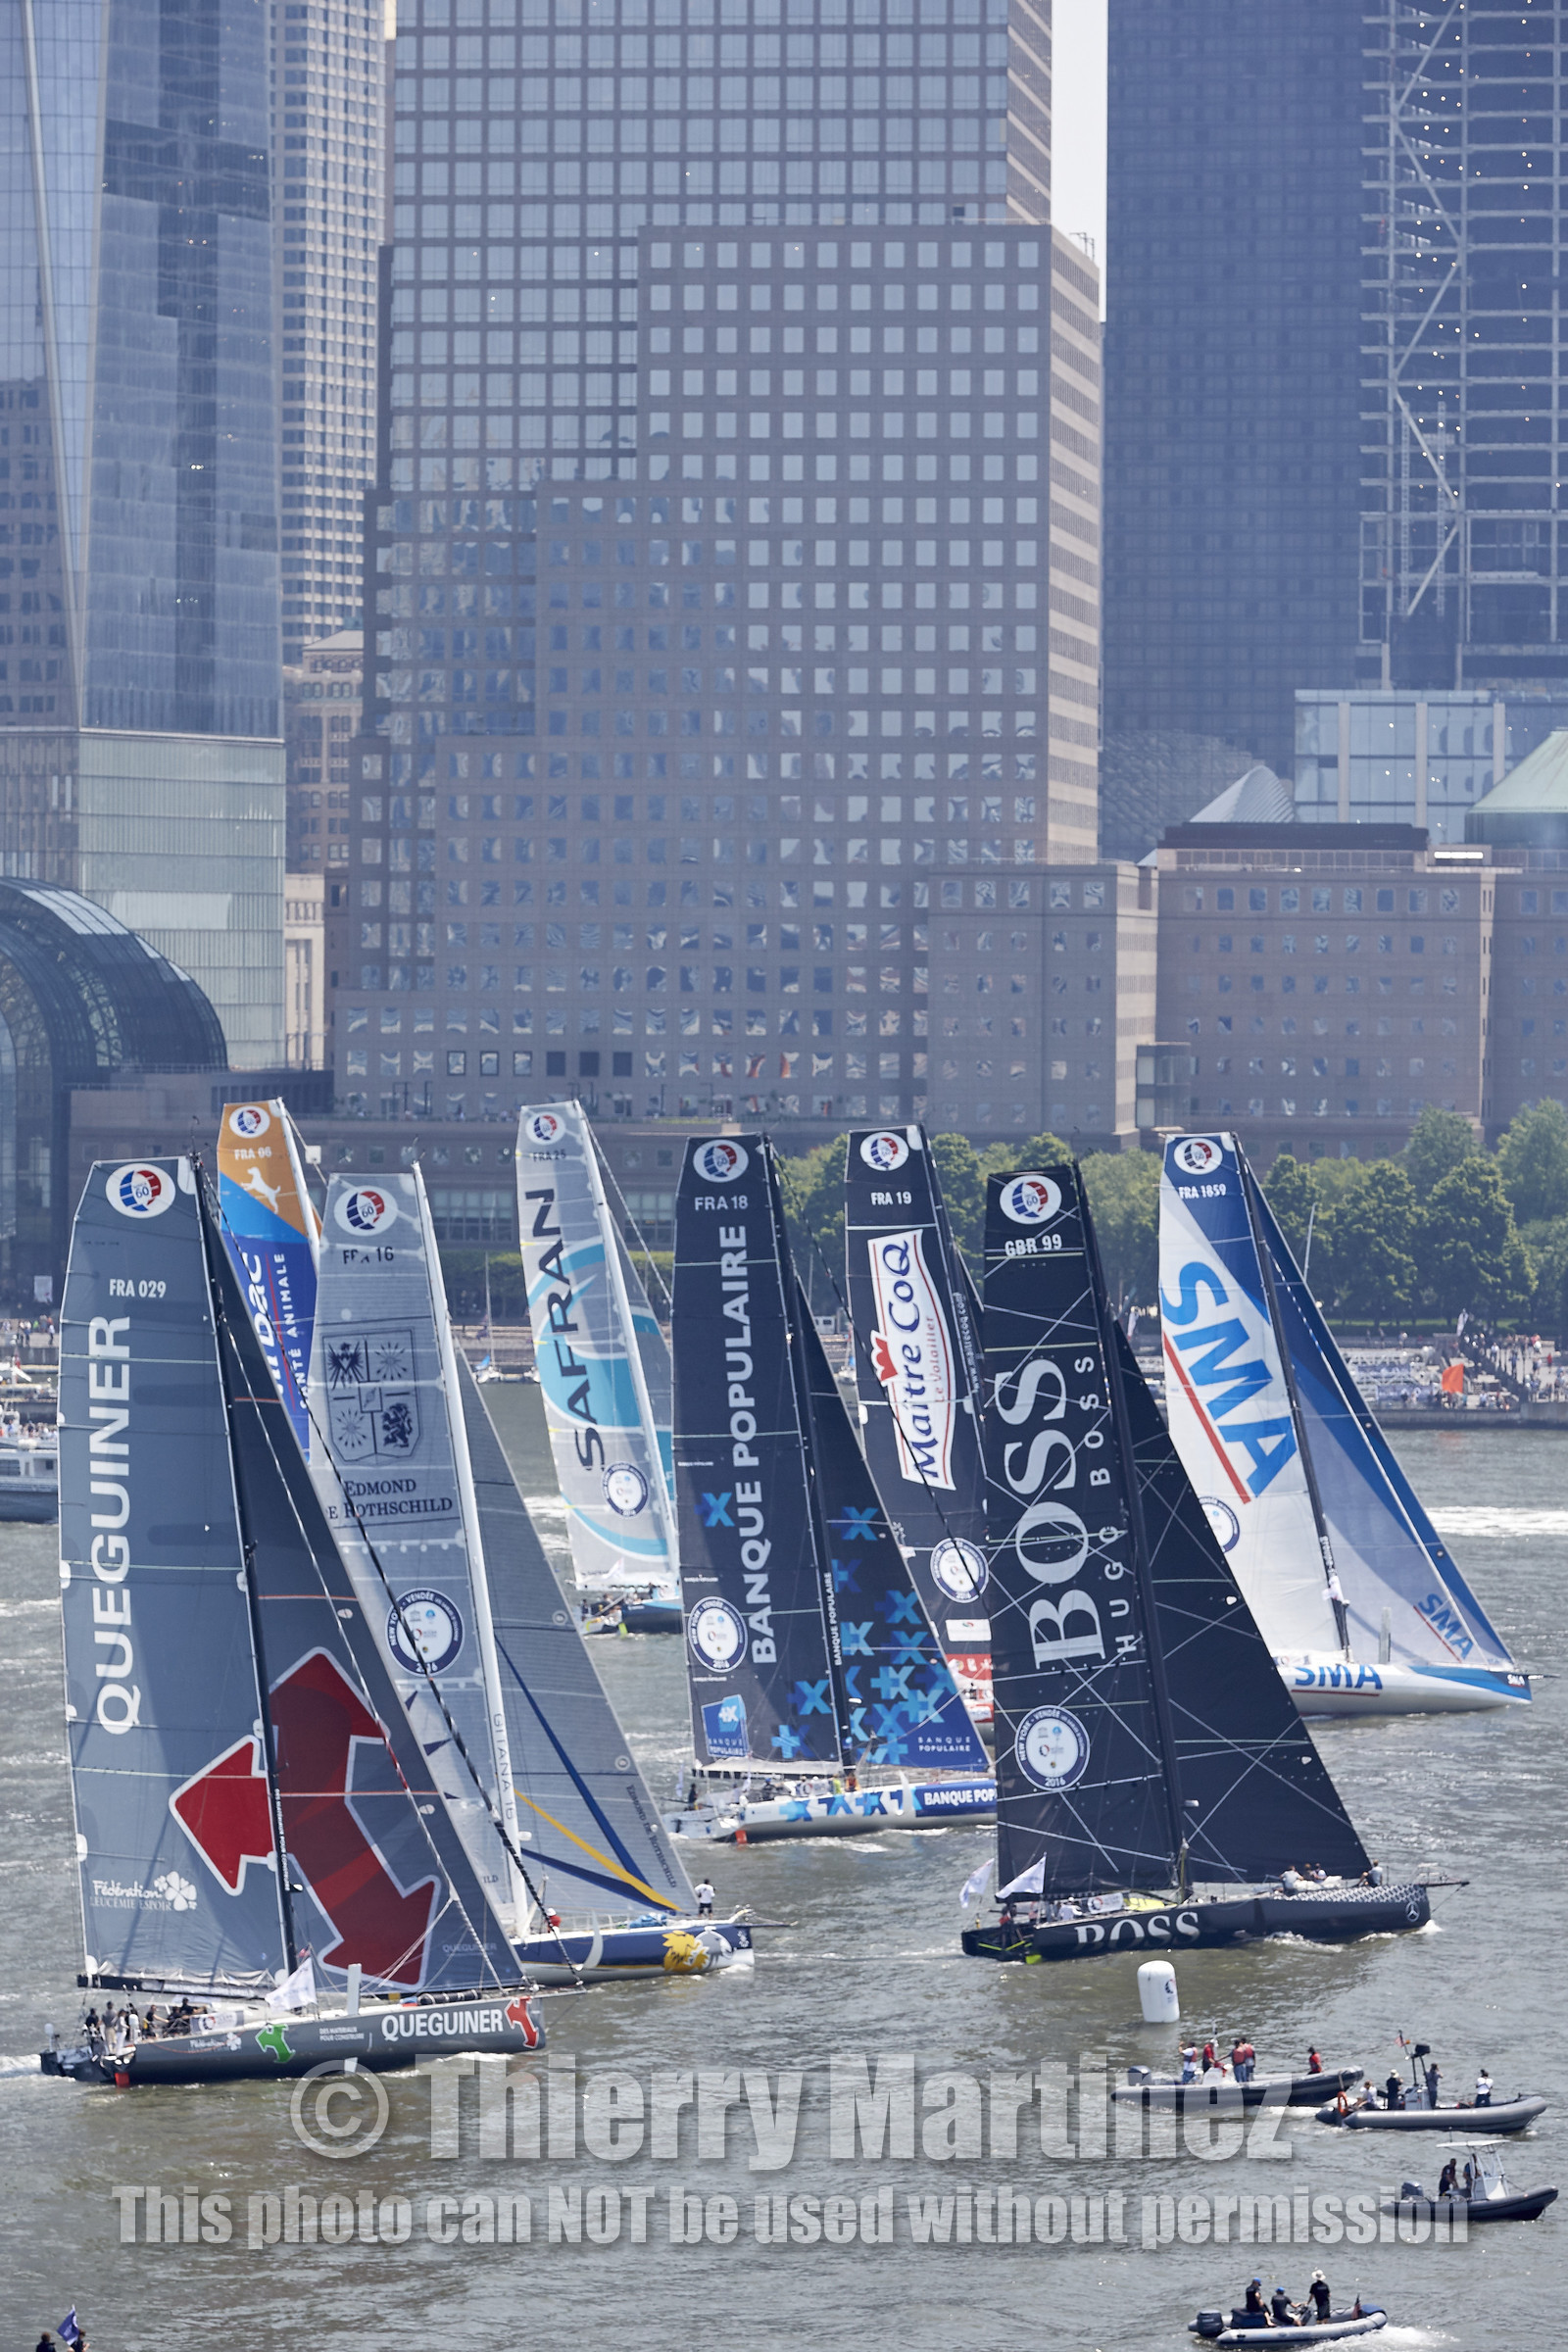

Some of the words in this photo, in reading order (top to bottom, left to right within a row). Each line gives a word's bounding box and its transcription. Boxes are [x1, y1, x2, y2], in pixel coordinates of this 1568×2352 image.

[234, 1148, 256, 1160] FRA
[258, 1146, 272, 1158] 06
[135, 1186, 149, 1199] 60
[695, 1196, 728, 1210] FRA
[730, 1195, 749, 1209] 18
[870, 1192, 893, 1205] FRA
[896, 1191, 912, 1204] 19
[1178, 1185, 1200, 1200] FRA
[1200, 1183, 1226, 1198] 1859
[362, 1205, 374, 1218] 60
[376, 1246, 394, 1262] 16
[1004, 1238, 1038, 1256] GBR
[1042, 1233, 1062, 1250] 99
[109, 1278, 135, 1298] FRA
[138, 1279, 167, 1298] 029
[274, 1253, 298, 1338] ANIMALE
[883, 1240, 920, 1333] CoQ
[525, 1188, 606, 1472] SAFRAN
[719, 1225, 760, 1467] POPULAIRE
[288, 1348, 309, 1410] SANTÉ
[1160, 1261, 1298, 1497] SMA
[935, 1387, 945, 1402] Le
[902, 1344, 939, 1478] Maître
[1074, 1356, 1111, 1487] BOSS
[344, 1479, 416, 1497] EDMOND
[343, 1497, 453, 1518] ROTHSCHILD
[995, 1358, 1106, 1670] BOSS
[88, 1316, 141, 1735] QUEGUINER
[735, 1480, 777, 1664] BANQUE
[1099, 1525, 1137, 1653] HUGO
[823, 1572, 837, 1624] POPULAIRE
[831, 1626, 842, 1666] BANQUE
[1418, 1592, 1474, 1660] SMA
[1295, 1663, 1383, 1690] SMA
[1018, 1742, 1027, 1761] NEW
[1045, 1777, 1066, 1788] 2016
[923, 1789, 973, 1806] BANQUE
[1074, 1911, 1201, 1947] BOSS
[381, 2009, 504, 2041] QUEGUINER
